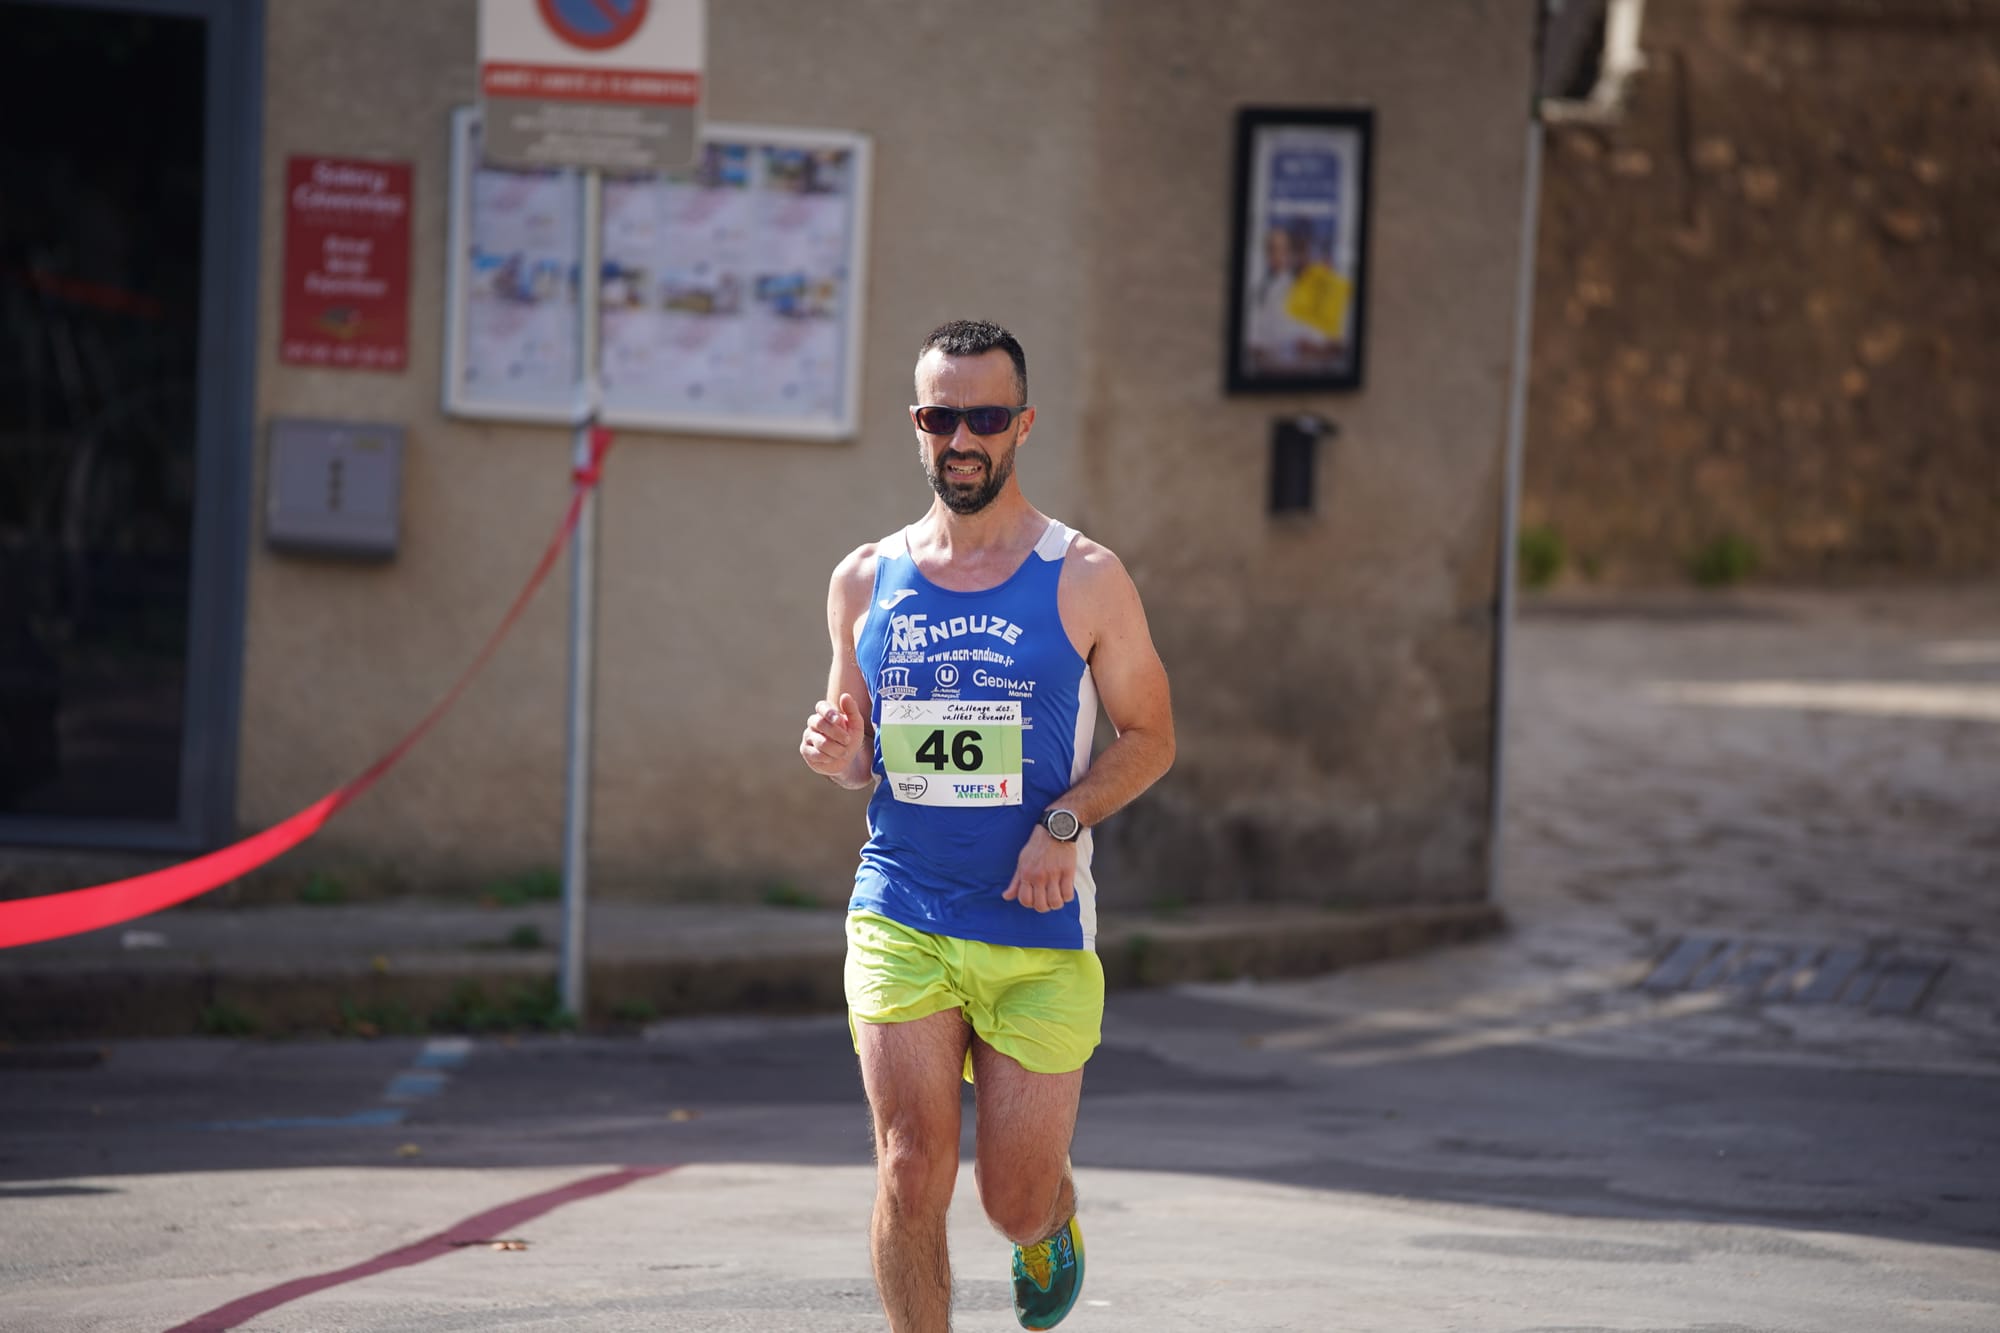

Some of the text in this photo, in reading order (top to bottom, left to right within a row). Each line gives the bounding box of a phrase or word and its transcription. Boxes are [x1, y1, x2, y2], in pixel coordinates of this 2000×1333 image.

[927, 647, 1015, 667] www.acn-anduze.fr
[947, 704, 991, 714] Challenge
[915, 729, 983, 771] 46
[953, 784, 995, 793] TUFF'S
[957, 791, 1000, 799] Aventure
